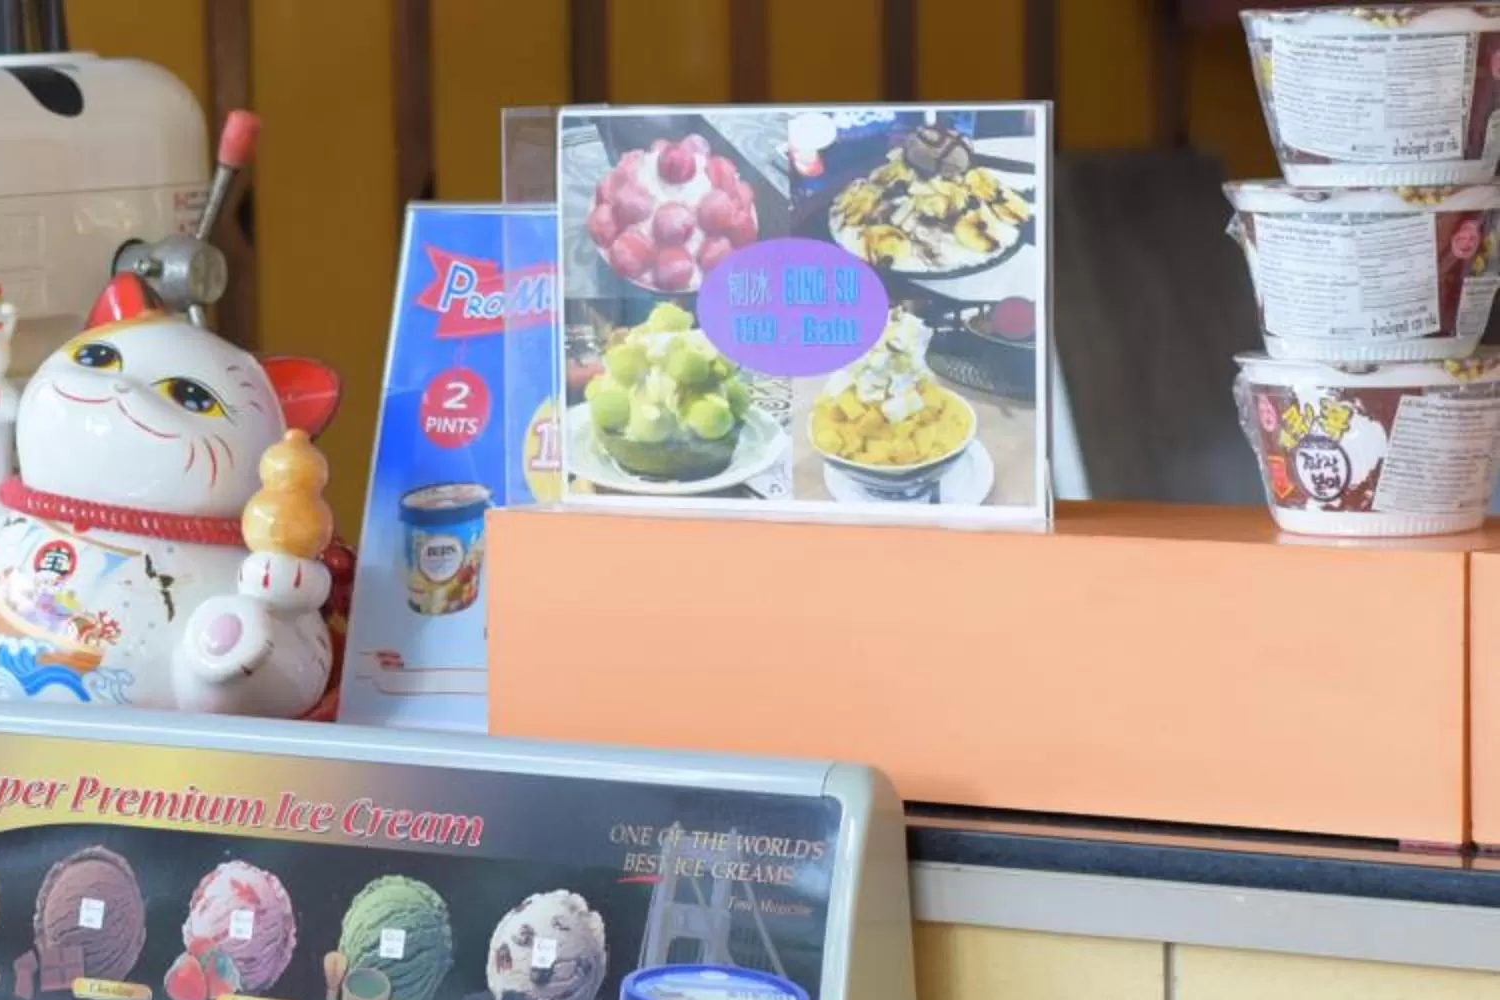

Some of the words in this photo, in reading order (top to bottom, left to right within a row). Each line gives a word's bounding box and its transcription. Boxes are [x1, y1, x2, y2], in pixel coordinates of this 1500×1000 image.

[443, 382, 470, 409] 2
[425, 416, 479, 435] PINTS
[70, 775, 266, 828] Premium
[270, 792, 336, 832] Ice
[341, 798, 484, 847] Cream
[609, 823, 652, 846] ONE
[658, 826, 686, 848] OF
[691, 830, 731, 851] THE
[623, 852, 666, 873] BEST
[674, 856, 706, 877] ICE
